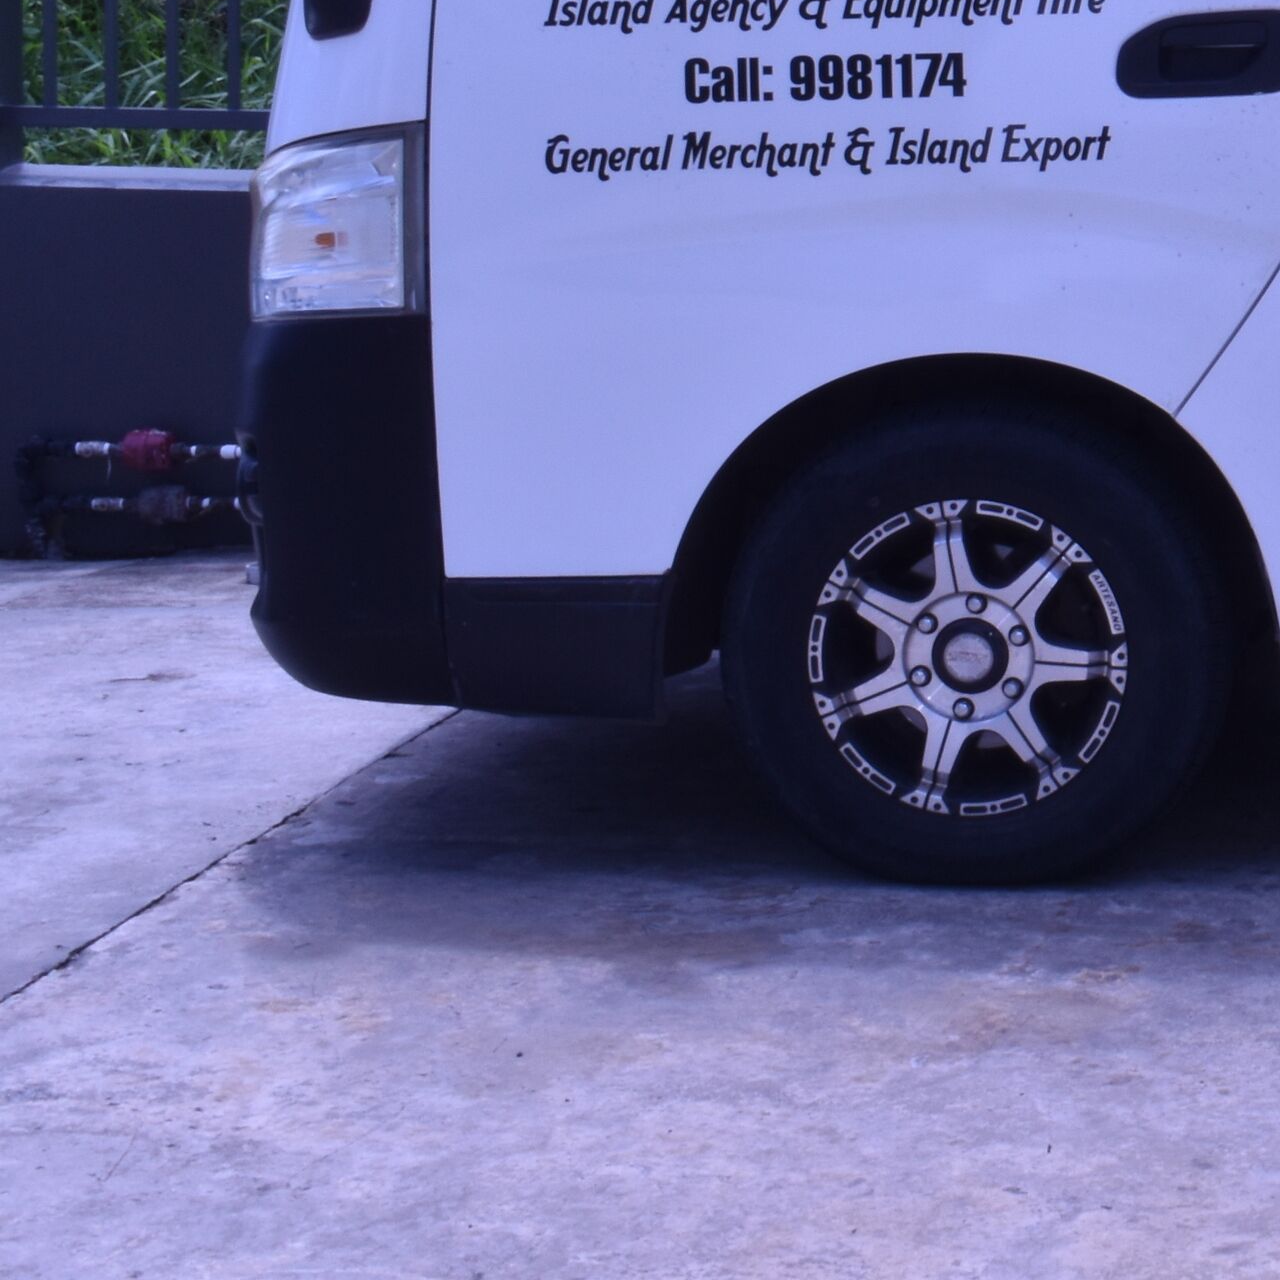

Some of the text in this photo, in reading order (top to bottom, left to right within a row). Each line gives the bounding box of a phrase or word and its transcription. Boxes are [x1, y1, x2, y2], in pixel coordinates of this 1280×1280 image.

[684, 52, 967, 104] Call: 9981174
[544, 123, 1112, 182] General Merchant & Island Export
